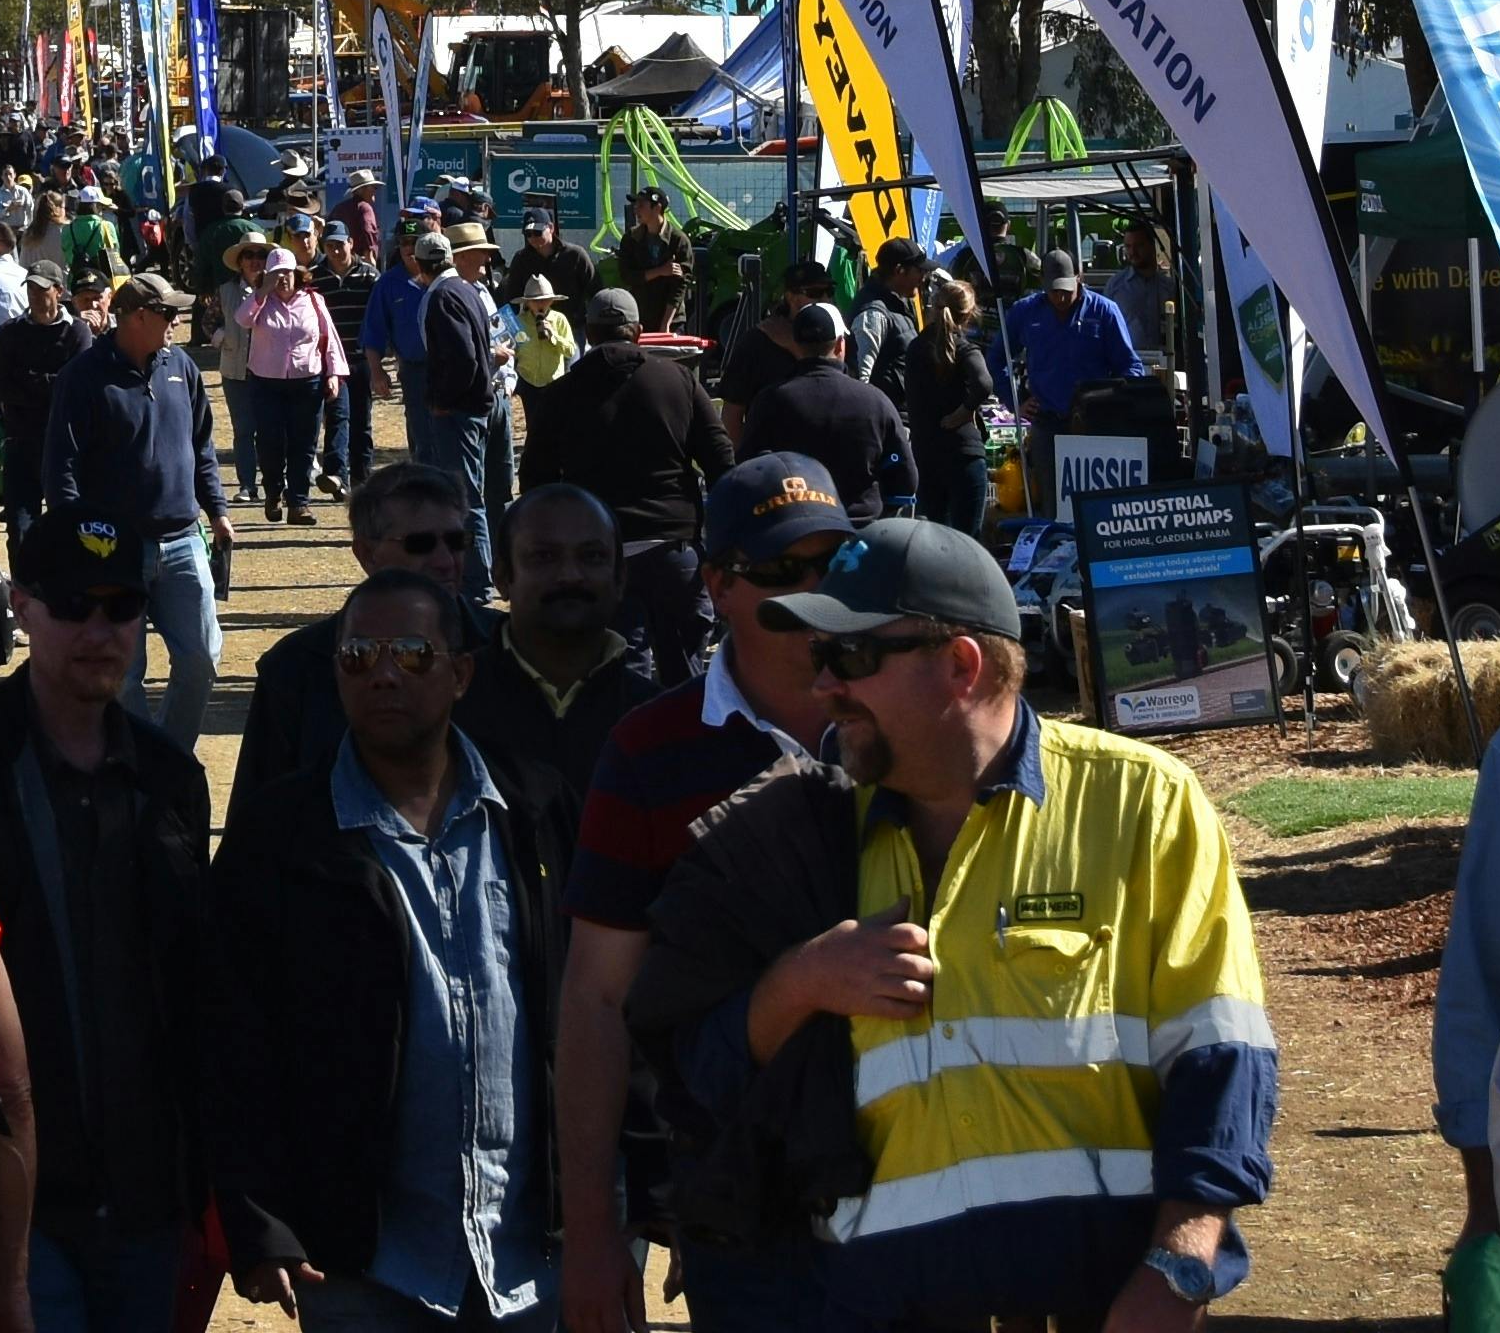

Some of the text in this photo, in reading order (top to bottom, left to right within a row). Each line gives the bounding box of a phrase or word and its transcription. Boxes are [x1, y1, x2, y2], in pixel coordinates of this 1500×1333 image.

[427, 157, 465, 172] Rapid
[536, 175, 579, 192] Rapid
[1391, 266, 1439, 290] with
[1111, 493, 1213, 517] INDUSTRIAL
[79, 521, 117, 537] USQ
[1095, 508, 1233, 537] QUALITY PUMPS
[1103, 539, 1122, 549] FOR
[1124, 537, 1153, 549] HOME,
[1155, 532, 1192, 544] GARDEN
[1204, 528, 1230, 539] FARM
[1145, 692, 1195, 708] Warrego
